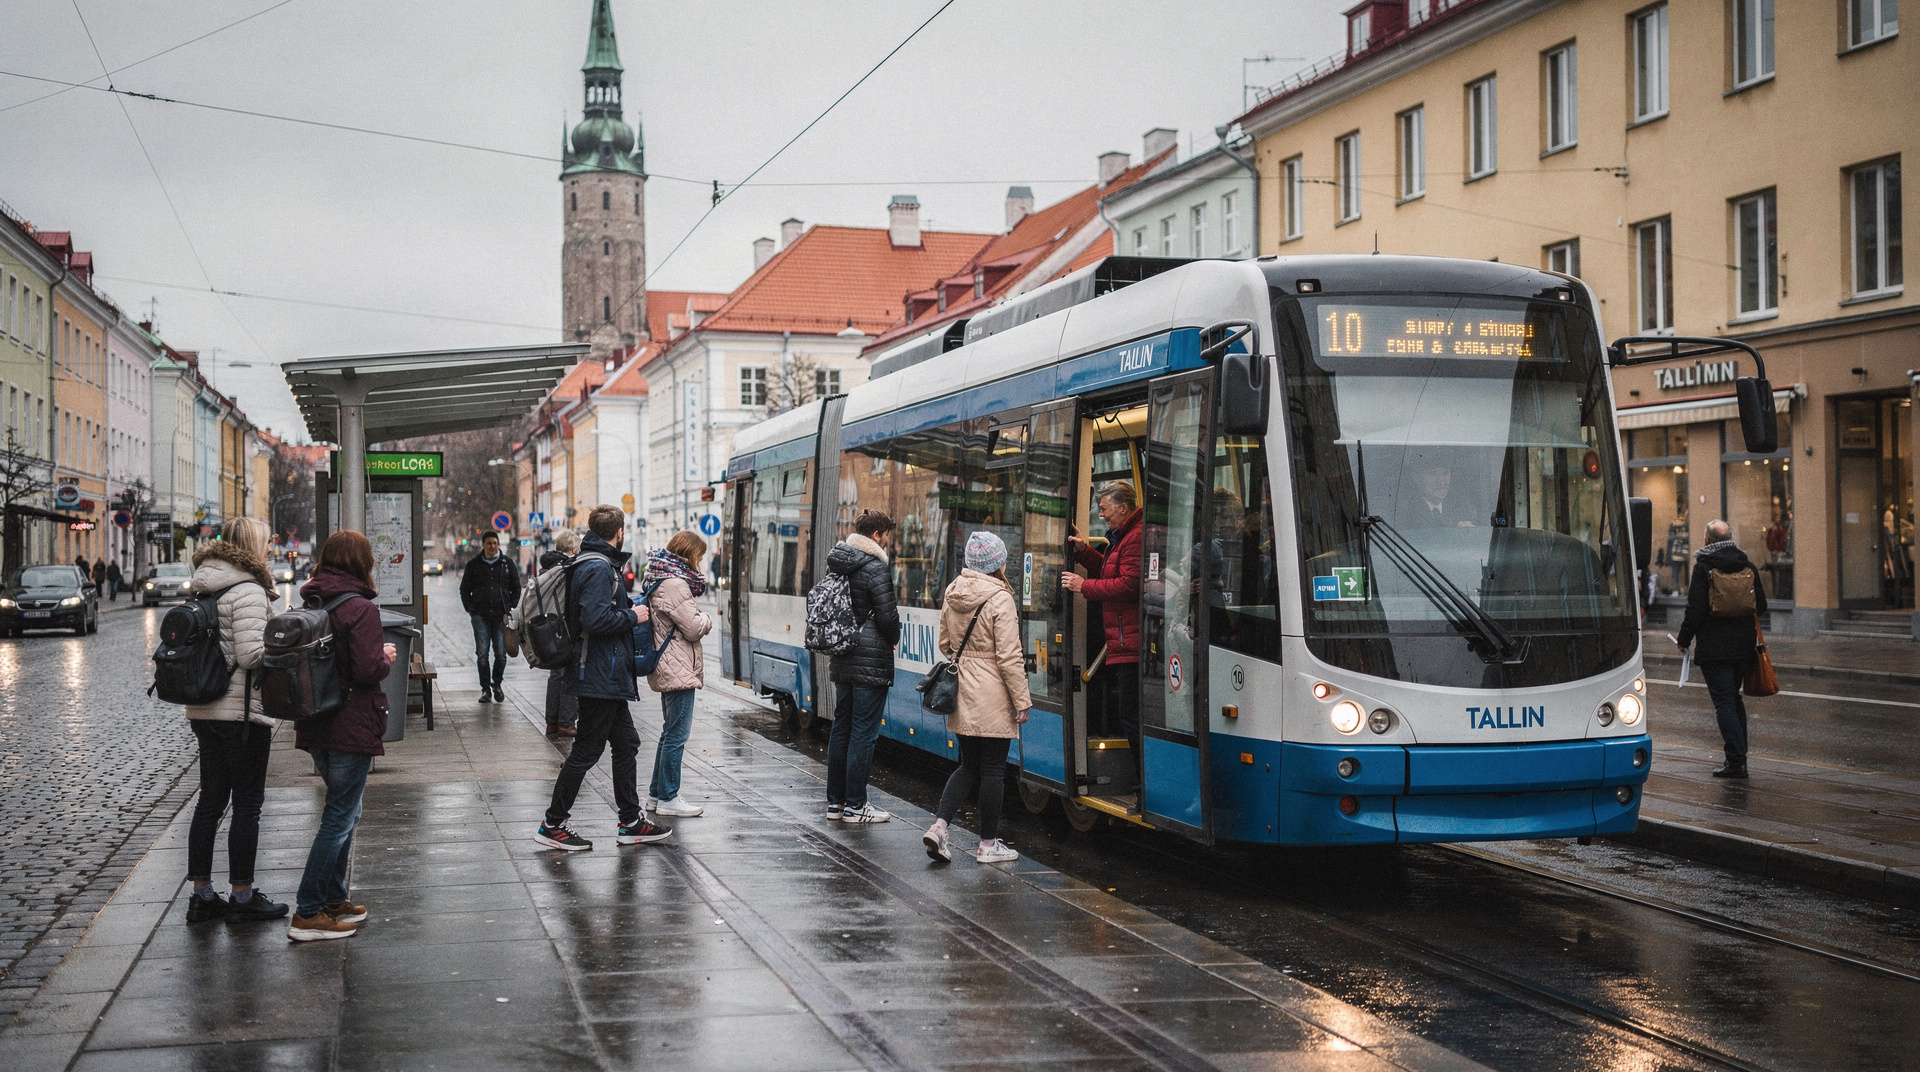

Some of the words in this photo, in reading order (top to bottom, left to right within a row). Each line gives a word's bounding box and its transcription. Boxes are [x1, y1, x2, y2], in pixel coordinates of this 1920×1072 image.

[1326, 312, 1361, 352] 10
[1233, 670, 1243, 685] 10
[1465, 705, 1544, 729] TALLIN
